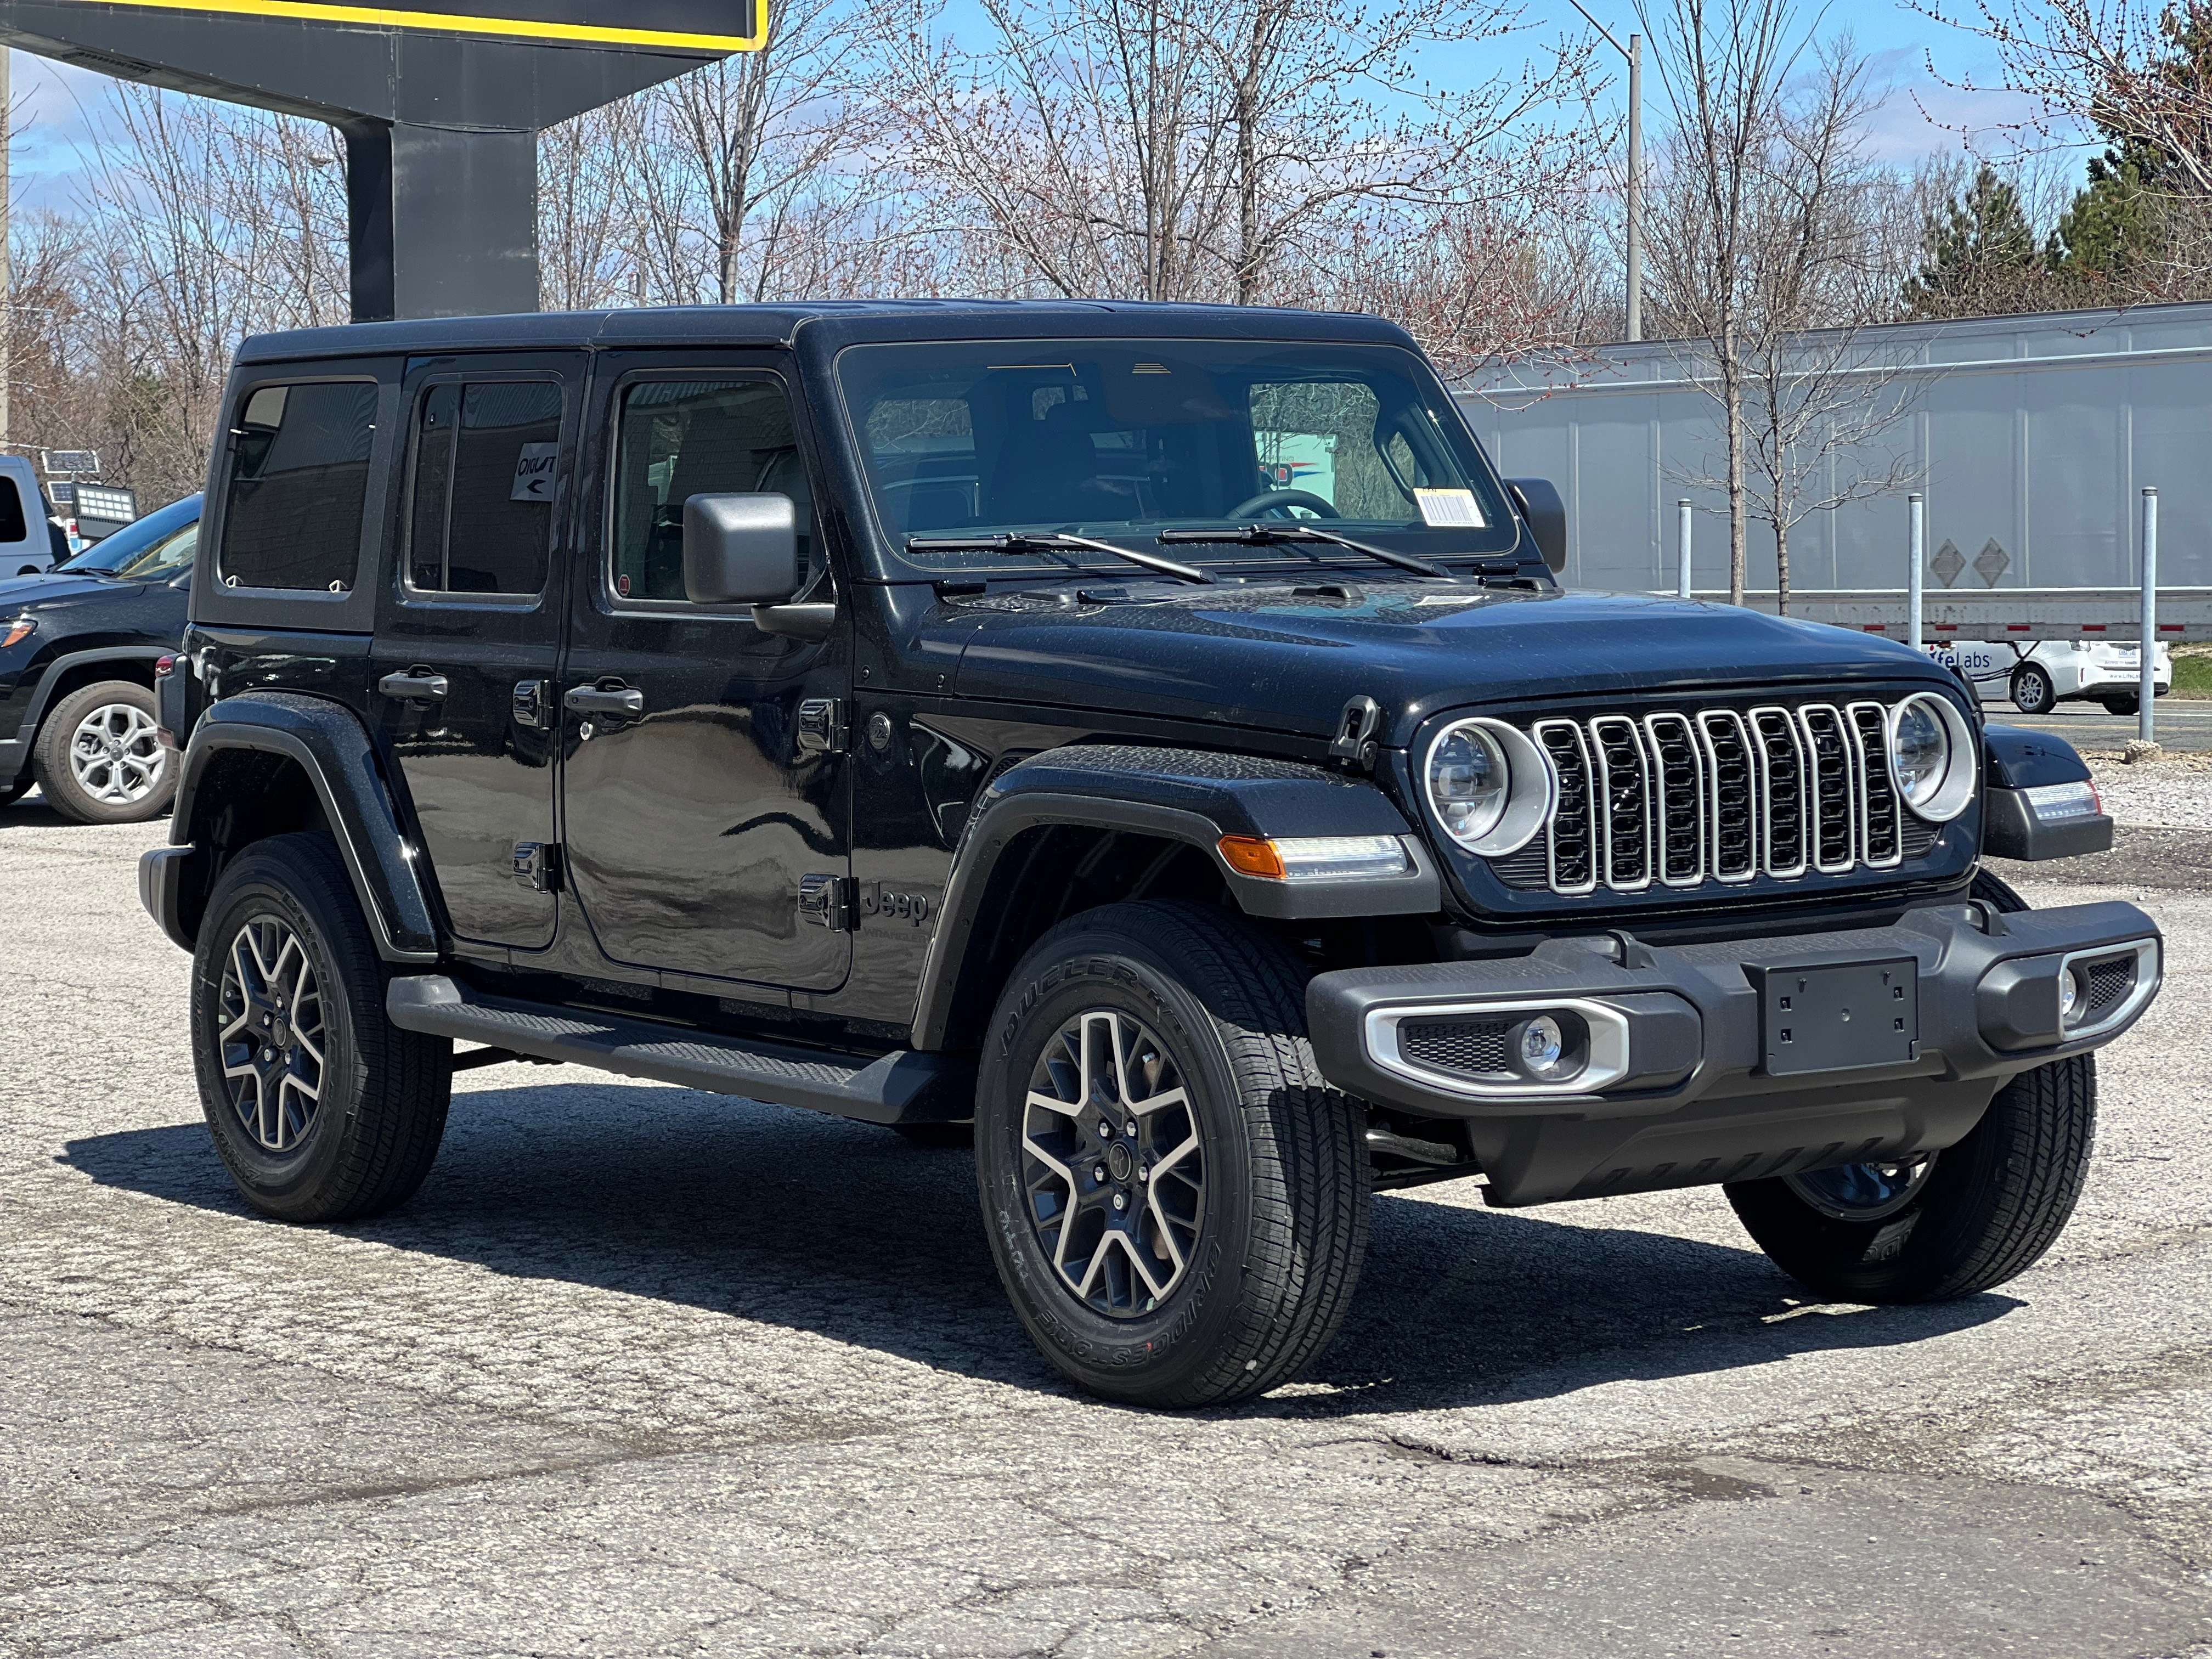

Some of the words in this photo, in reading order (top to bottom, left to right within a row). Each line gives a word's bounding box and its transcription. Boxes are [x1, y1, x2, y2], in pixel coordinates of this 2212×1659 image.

[861, 881, 928, 926] Jeep
[1000, 957, 1139, 1057] DUELER
[1037, 1241, 1222, 1369] BRIDGESTONE
